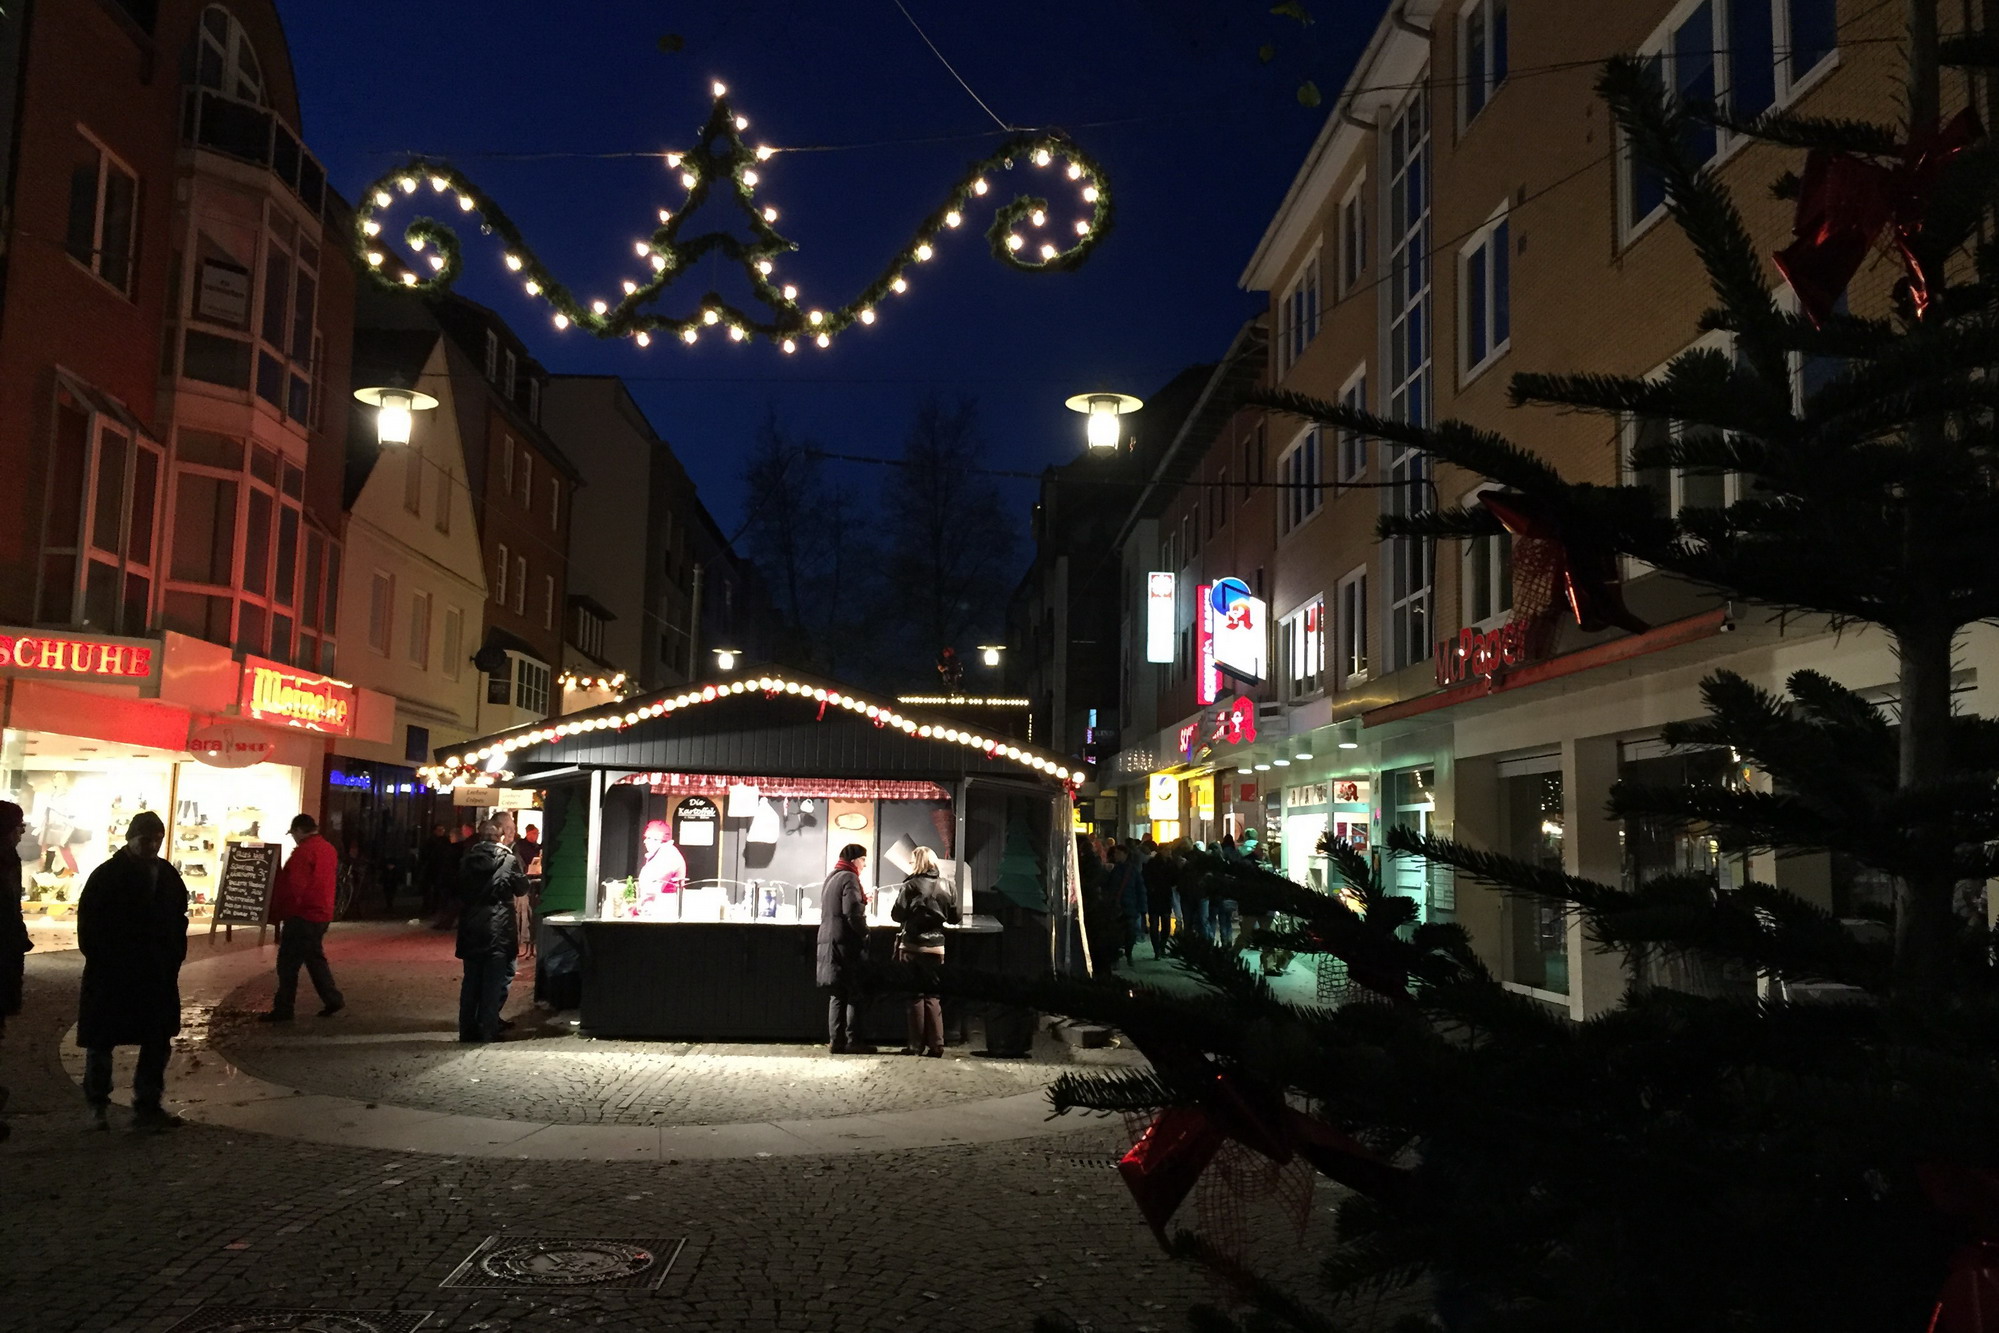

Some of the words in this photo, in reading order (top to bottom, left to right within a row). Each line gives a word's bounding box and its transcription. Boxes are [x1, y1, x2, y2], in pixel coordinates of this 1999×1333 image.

[250, 667, 347, 727] Meineke
[689, 798, 706, 806] Die
[678, 806, 716, 817] Kartoffel
